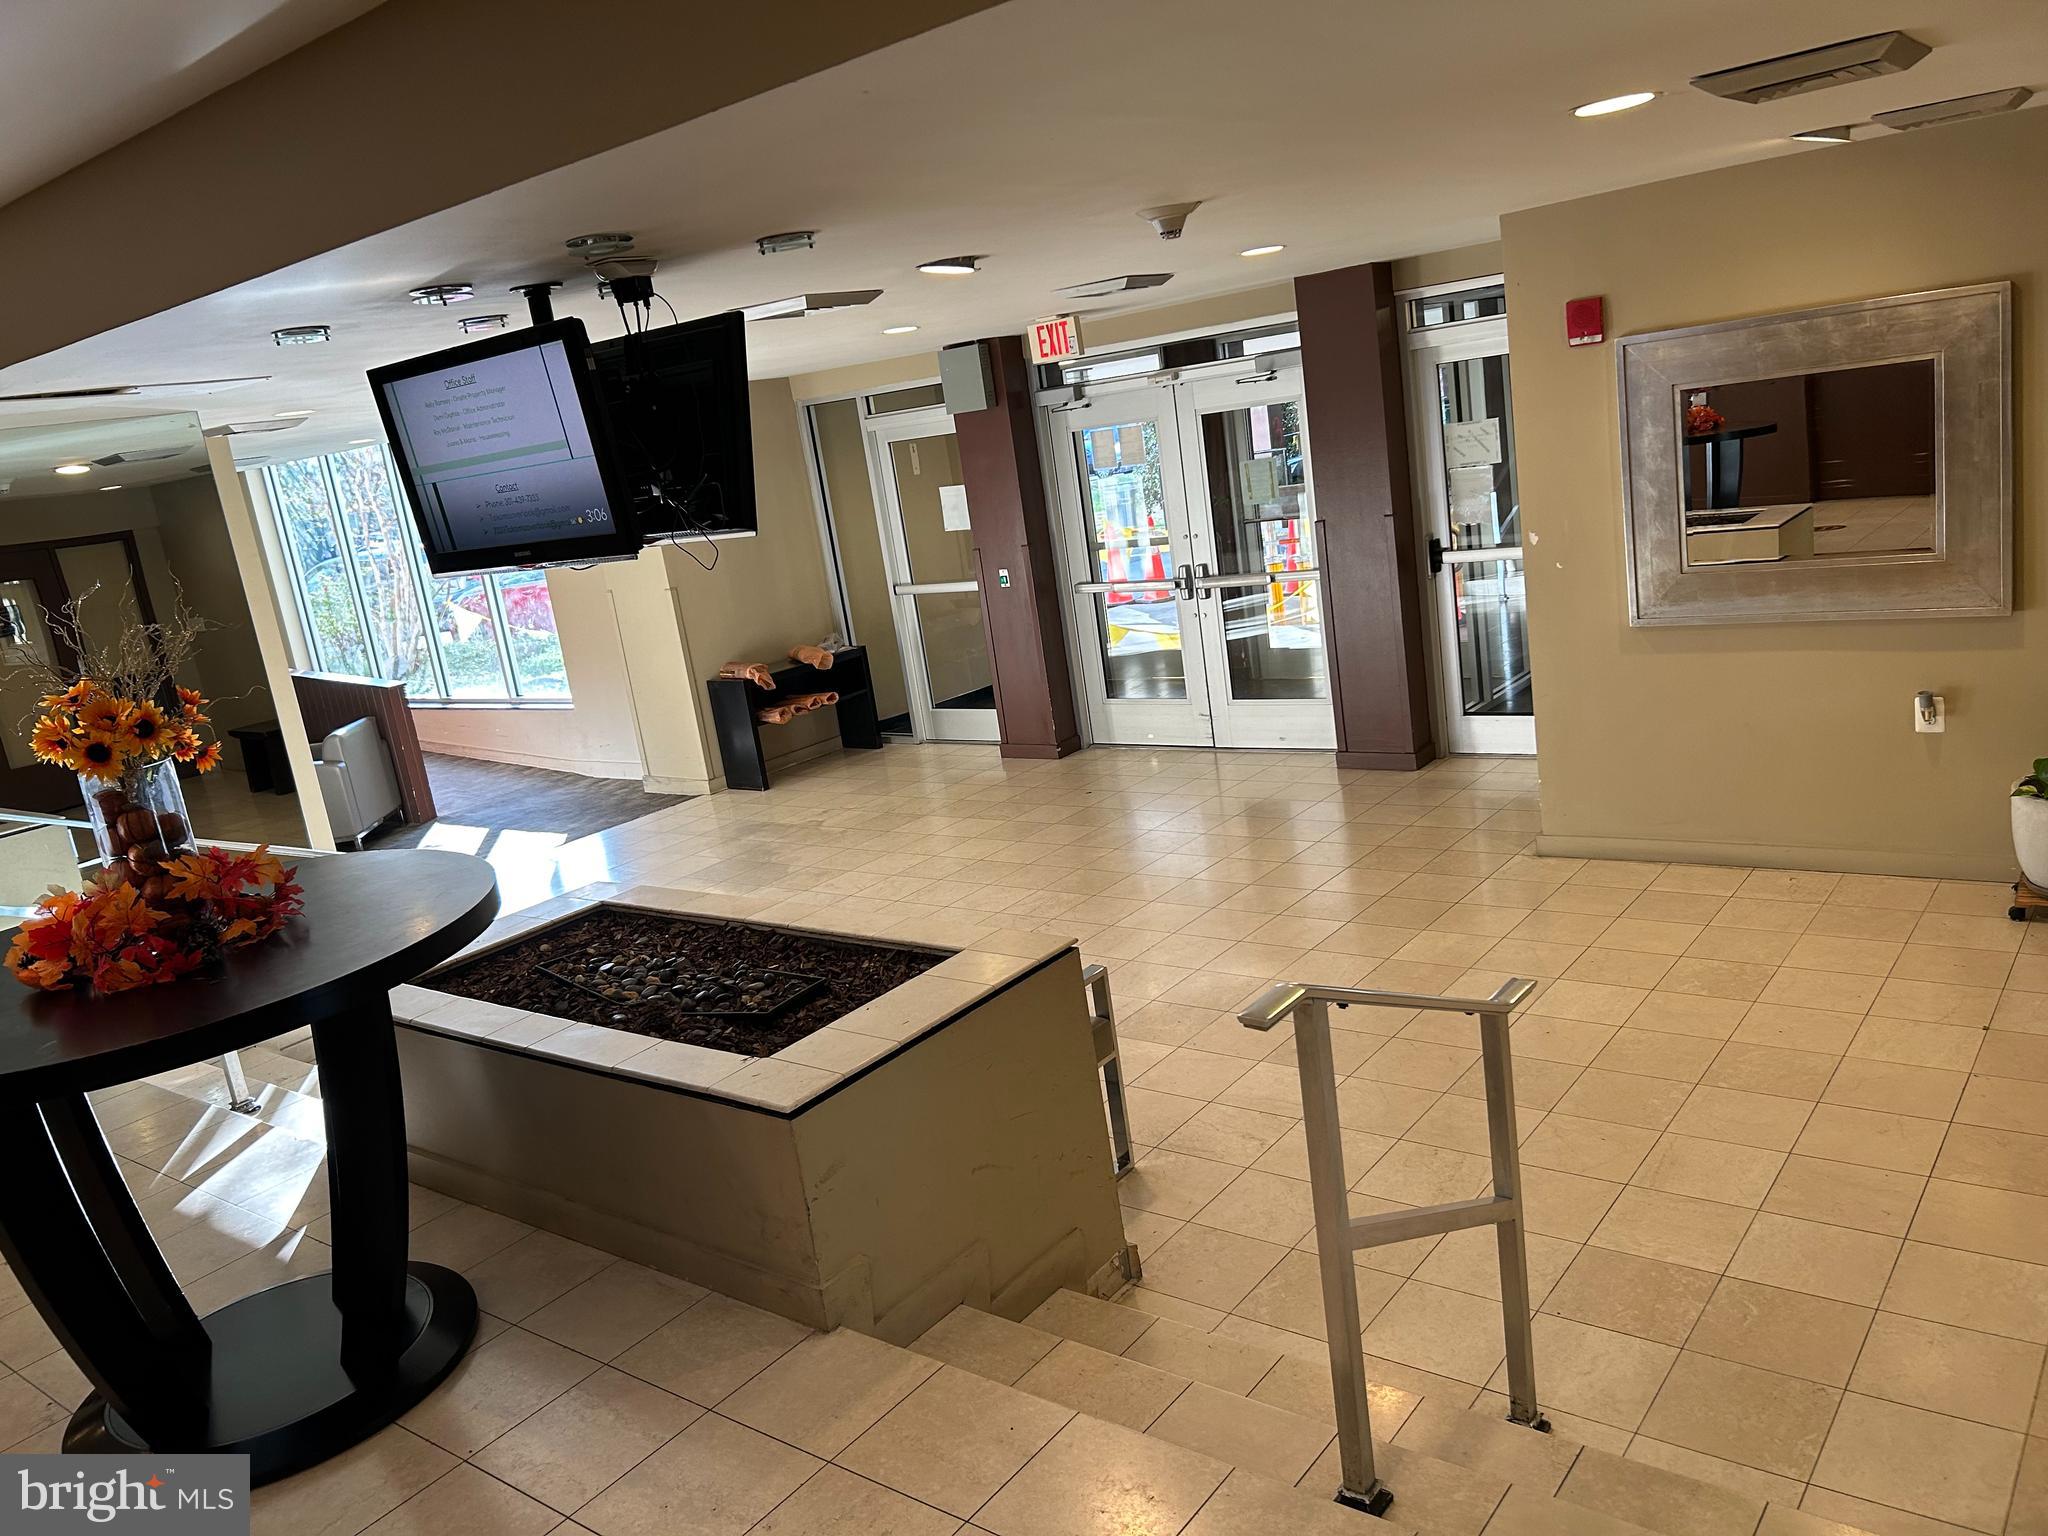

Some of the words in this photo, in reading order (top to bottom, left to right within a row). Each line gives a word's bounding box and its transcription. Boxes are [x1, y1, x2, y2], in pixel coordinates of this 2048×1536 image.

[1037, 322, 1070, 358] EXIT
[444, 378, 461, 389] Office
[462, 373, 477, 385] Staff
[495, 482, 519, 493] Contact
[585, 507, 608, 523] 3:06
